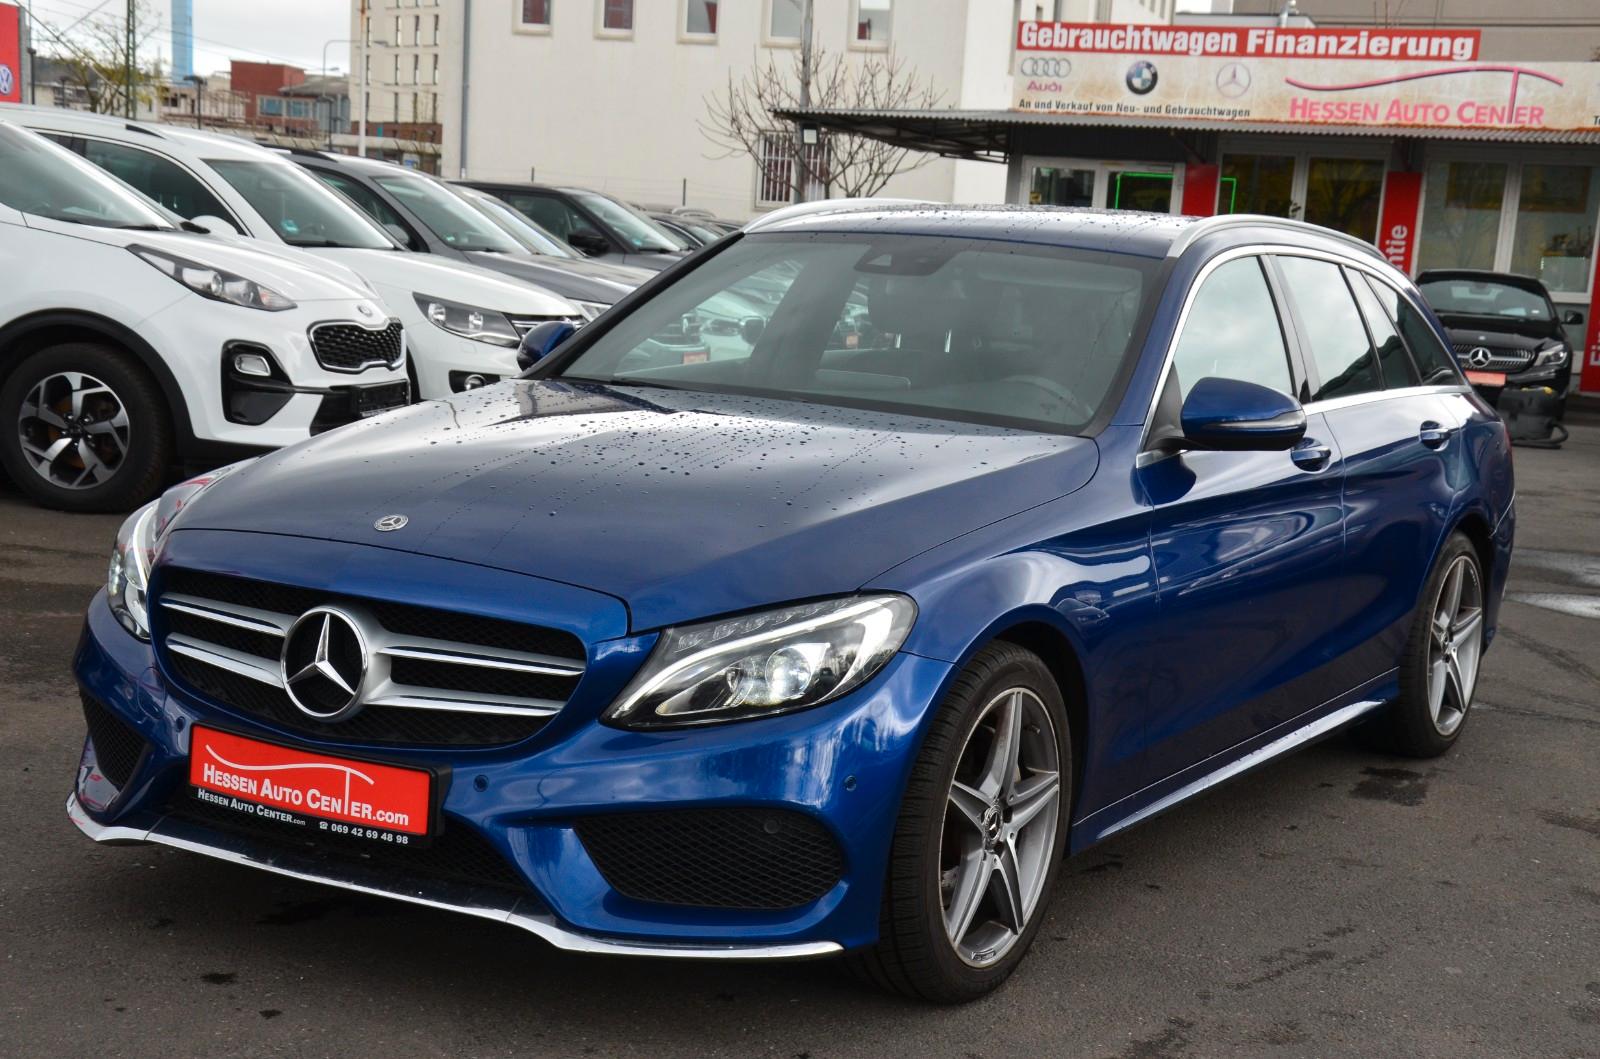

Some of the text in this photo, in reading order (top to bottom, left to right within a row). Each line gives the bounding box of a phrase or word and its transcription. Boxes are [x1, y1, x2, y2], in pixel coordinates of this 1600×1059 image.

[1020, 22, 1474, 61] Gebrauchtwagen Finanzierung
[1019, 99, 1251, 118] An und Verkauf von Neu- und Gebrauchtwagen
[1289, 97, 1544, 125] HESSEN AUTO CENTER
[198, 788, 229, 807] HESSEN
[230, 798, 255, 813] AUTO
[203, 763, 409, 826] HESSEN AUTO CENTER.com
[331, 823, 409, 845] 069 42 69 48 98
